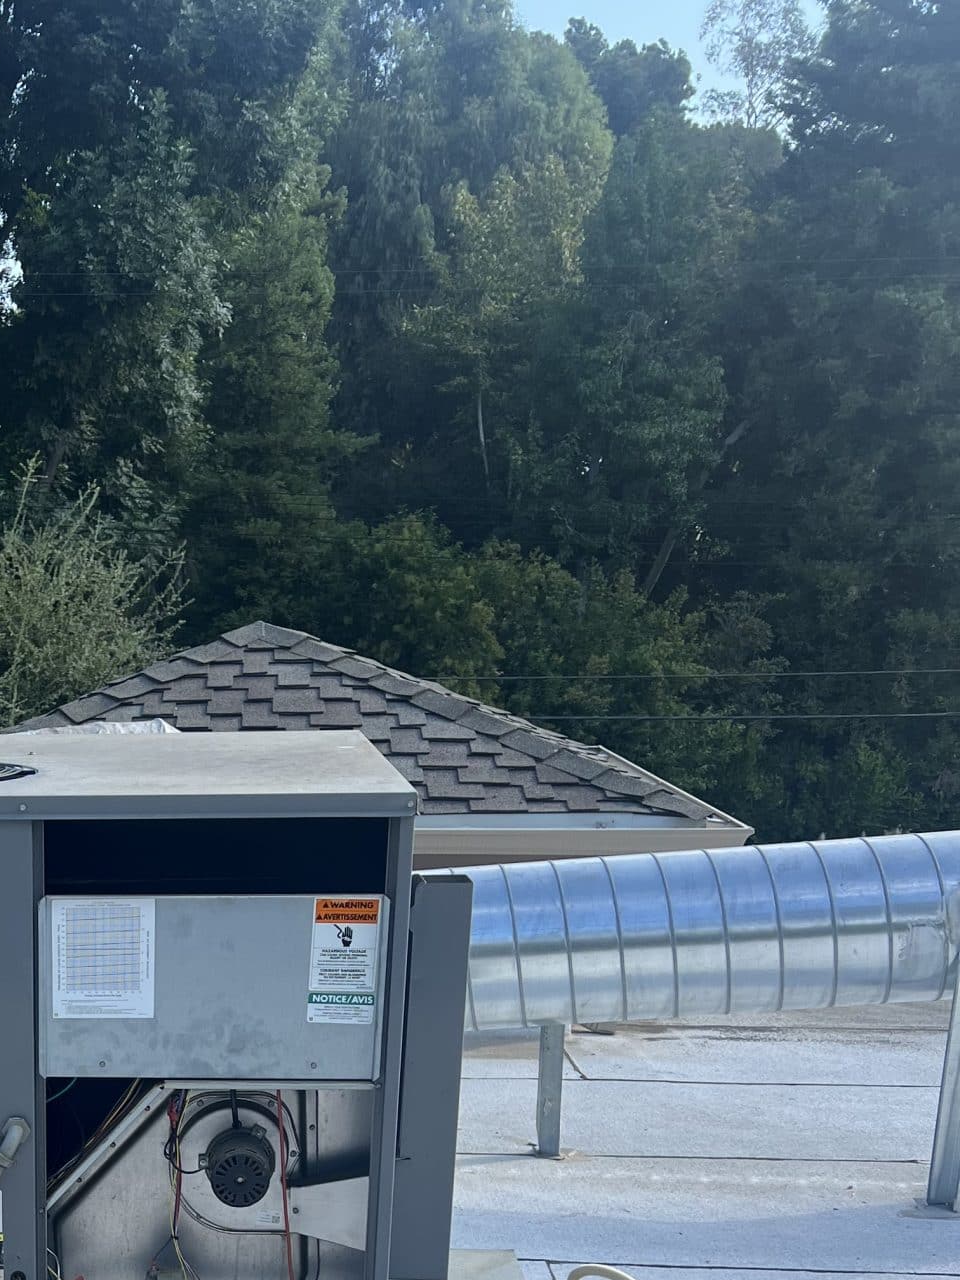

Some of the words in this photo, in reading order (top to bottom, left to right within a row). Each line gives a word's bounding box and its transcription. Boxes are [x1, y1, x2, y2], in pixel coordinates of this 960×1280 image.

[330, 901, 374, 910] WARNING
[323, 913, 378, 922] AVERTISSEMENT
[312, 994, 374, 1004] NOTICE/AVIS
